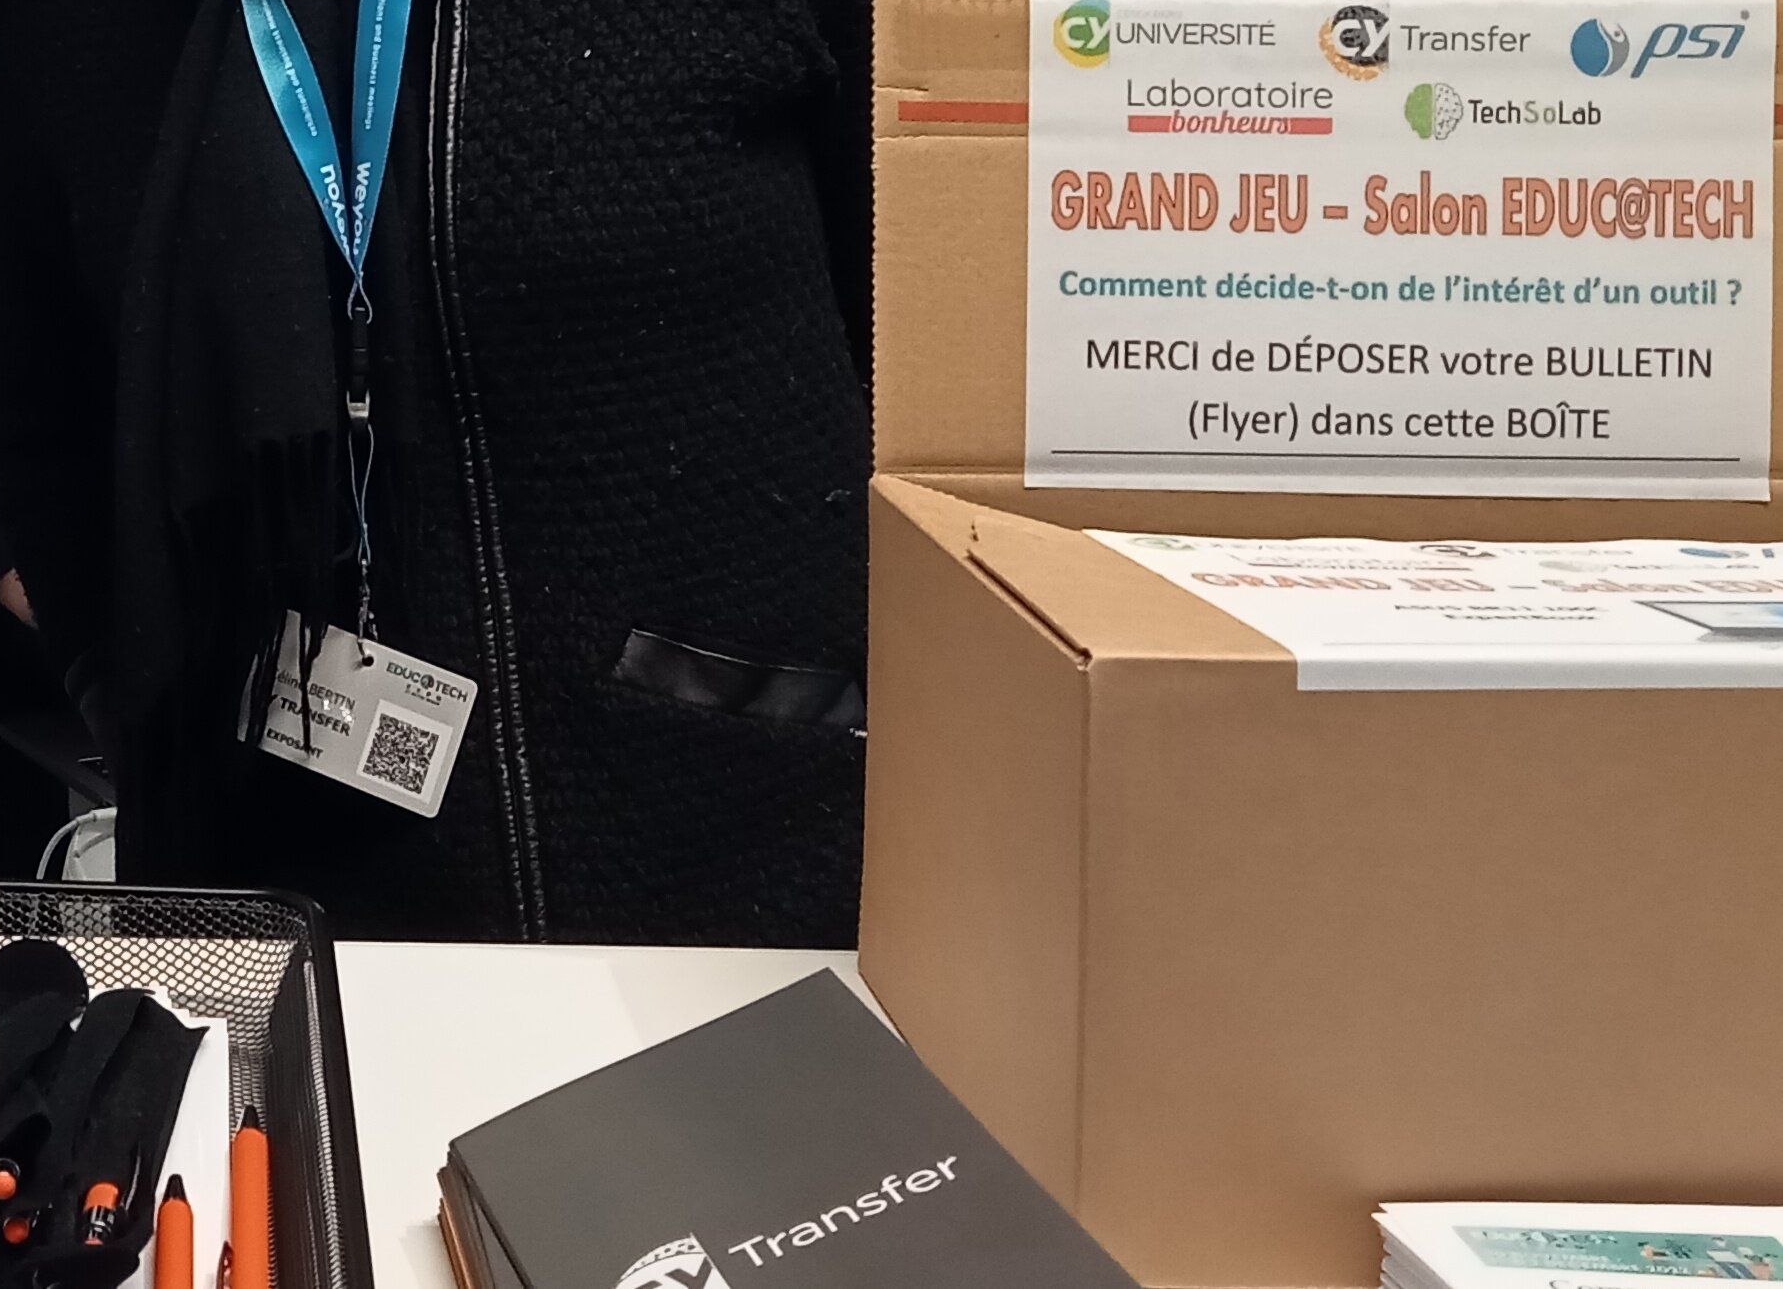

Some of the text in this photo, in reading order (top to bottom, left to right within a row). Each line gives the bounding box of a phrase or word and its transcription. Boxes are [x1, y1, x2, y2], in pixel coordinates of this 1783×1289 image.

[1117, 23, 1275, 46] UNIVERSITÉ
[1400, 25, 1530, 52] Transfer
[1128, 78, 1333, 113] Laboratoire
[1171, 109, 1291, 135] bonheurs
[352, 162, 371, 255] weyou
[1051, 170, 1219, 231] GRAND
[1229, 174, 1308, 234] JEU
[1364, 170, 1487, 236] Salon
[1502, 177, 1753, 240] EDUC@TECH
[1060, 271, 1206, 298] Comment
[1216, 273, 1388, 300] décide-t-on
[1399, 275, 1435, 301] de
[1650, 279, 1716, 305] outil
[1087, 335, 1711, 378] MERCI de DÉPOSER votre BULLETIN
[1189, 401, 1609, 441] (Flyer) dans cette BOÎTE
[728, 1152, 959, 1268] Transfer
